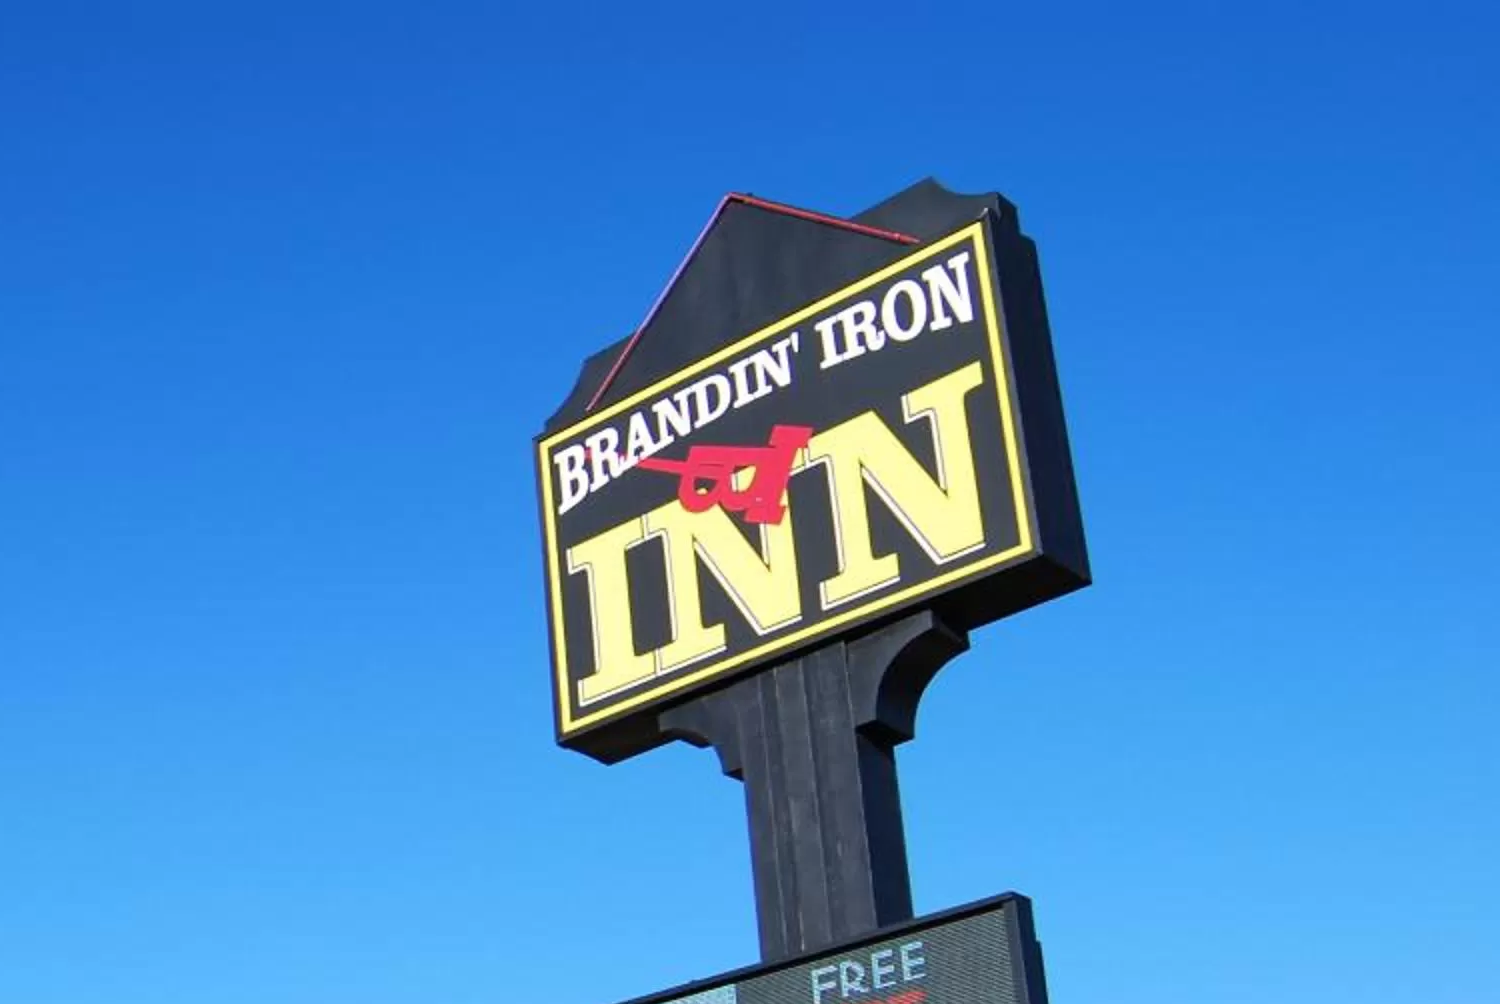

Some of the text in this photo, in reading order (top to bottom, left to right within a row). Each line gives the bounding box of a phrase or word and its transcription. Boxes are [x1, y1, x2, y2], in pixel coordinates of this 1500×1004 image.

[553, 252, 975, 515] BRANDIN' IRON
[566, 360, 986, 707] INN
[812, 940, 927, 1004] FREE
